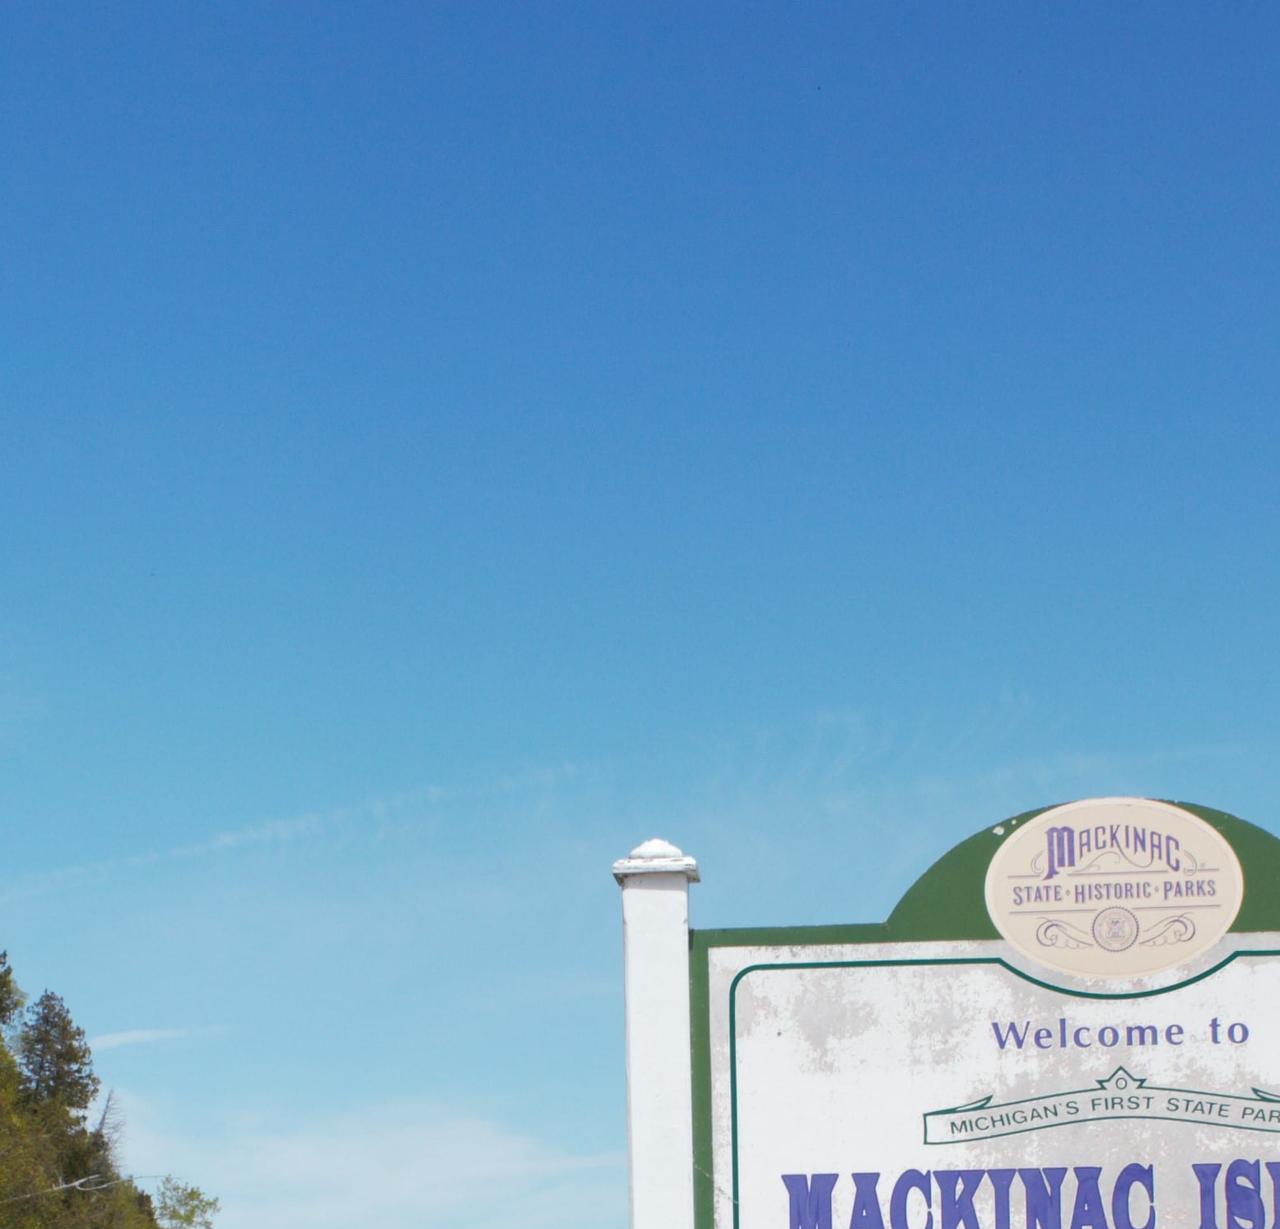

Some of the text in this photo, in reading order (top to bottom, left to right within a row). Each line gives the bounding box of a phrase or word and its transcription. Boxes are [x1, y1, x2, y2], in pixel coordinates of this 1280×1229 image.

[1042, 824, 1180, 880] MACKINAC
[1013, 879, 1216, 906] STATE HISTORIC PARKS
[991, 1017, 1250, 1049] Welcome to
[950, 1100, 1080, 1135] MICHIGAN'S
[1091, 1096, 1155, 1112] FIRST
[1166, 1097, 1230, 1118] STATE
